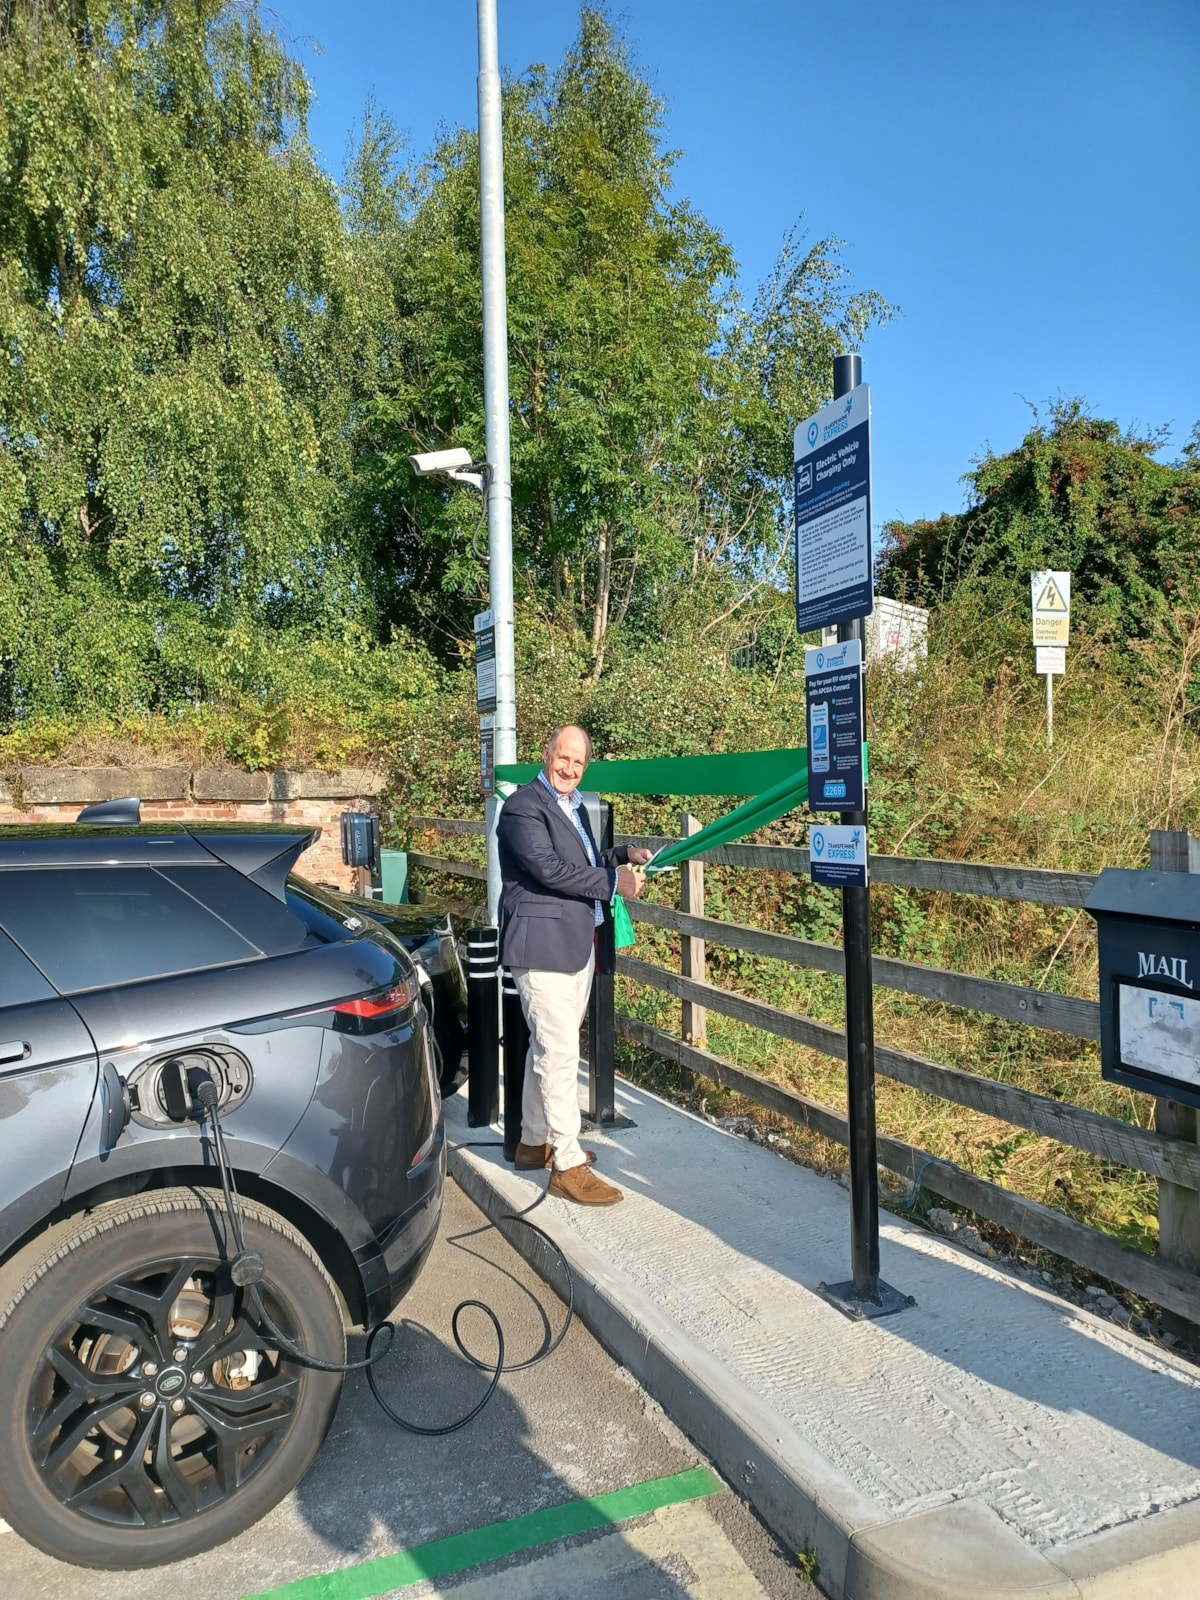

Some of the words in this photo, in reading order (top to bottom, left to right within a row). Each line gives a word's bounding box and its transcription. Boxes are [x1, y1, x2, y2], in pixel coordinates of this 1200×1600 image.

[824, 420, 848, 441] EXPRESS
[816, 453, 837, 471] Electric
[838, 441, 859, 457] Vehicle
[816, 463, 841, 482] Charging
[842, 454, 856, 468] Only
[1036, 618, 1062, 627] Danger
[823, 678, 832, 686] your
[839, 673, 857, 681] charging
[833, 684, 850, 692] Connect
[825, 786, 845, 796] 22691
[828, 849, 855, 859] EXPRESS
[1137, 952, 1194, 989] MAIL
